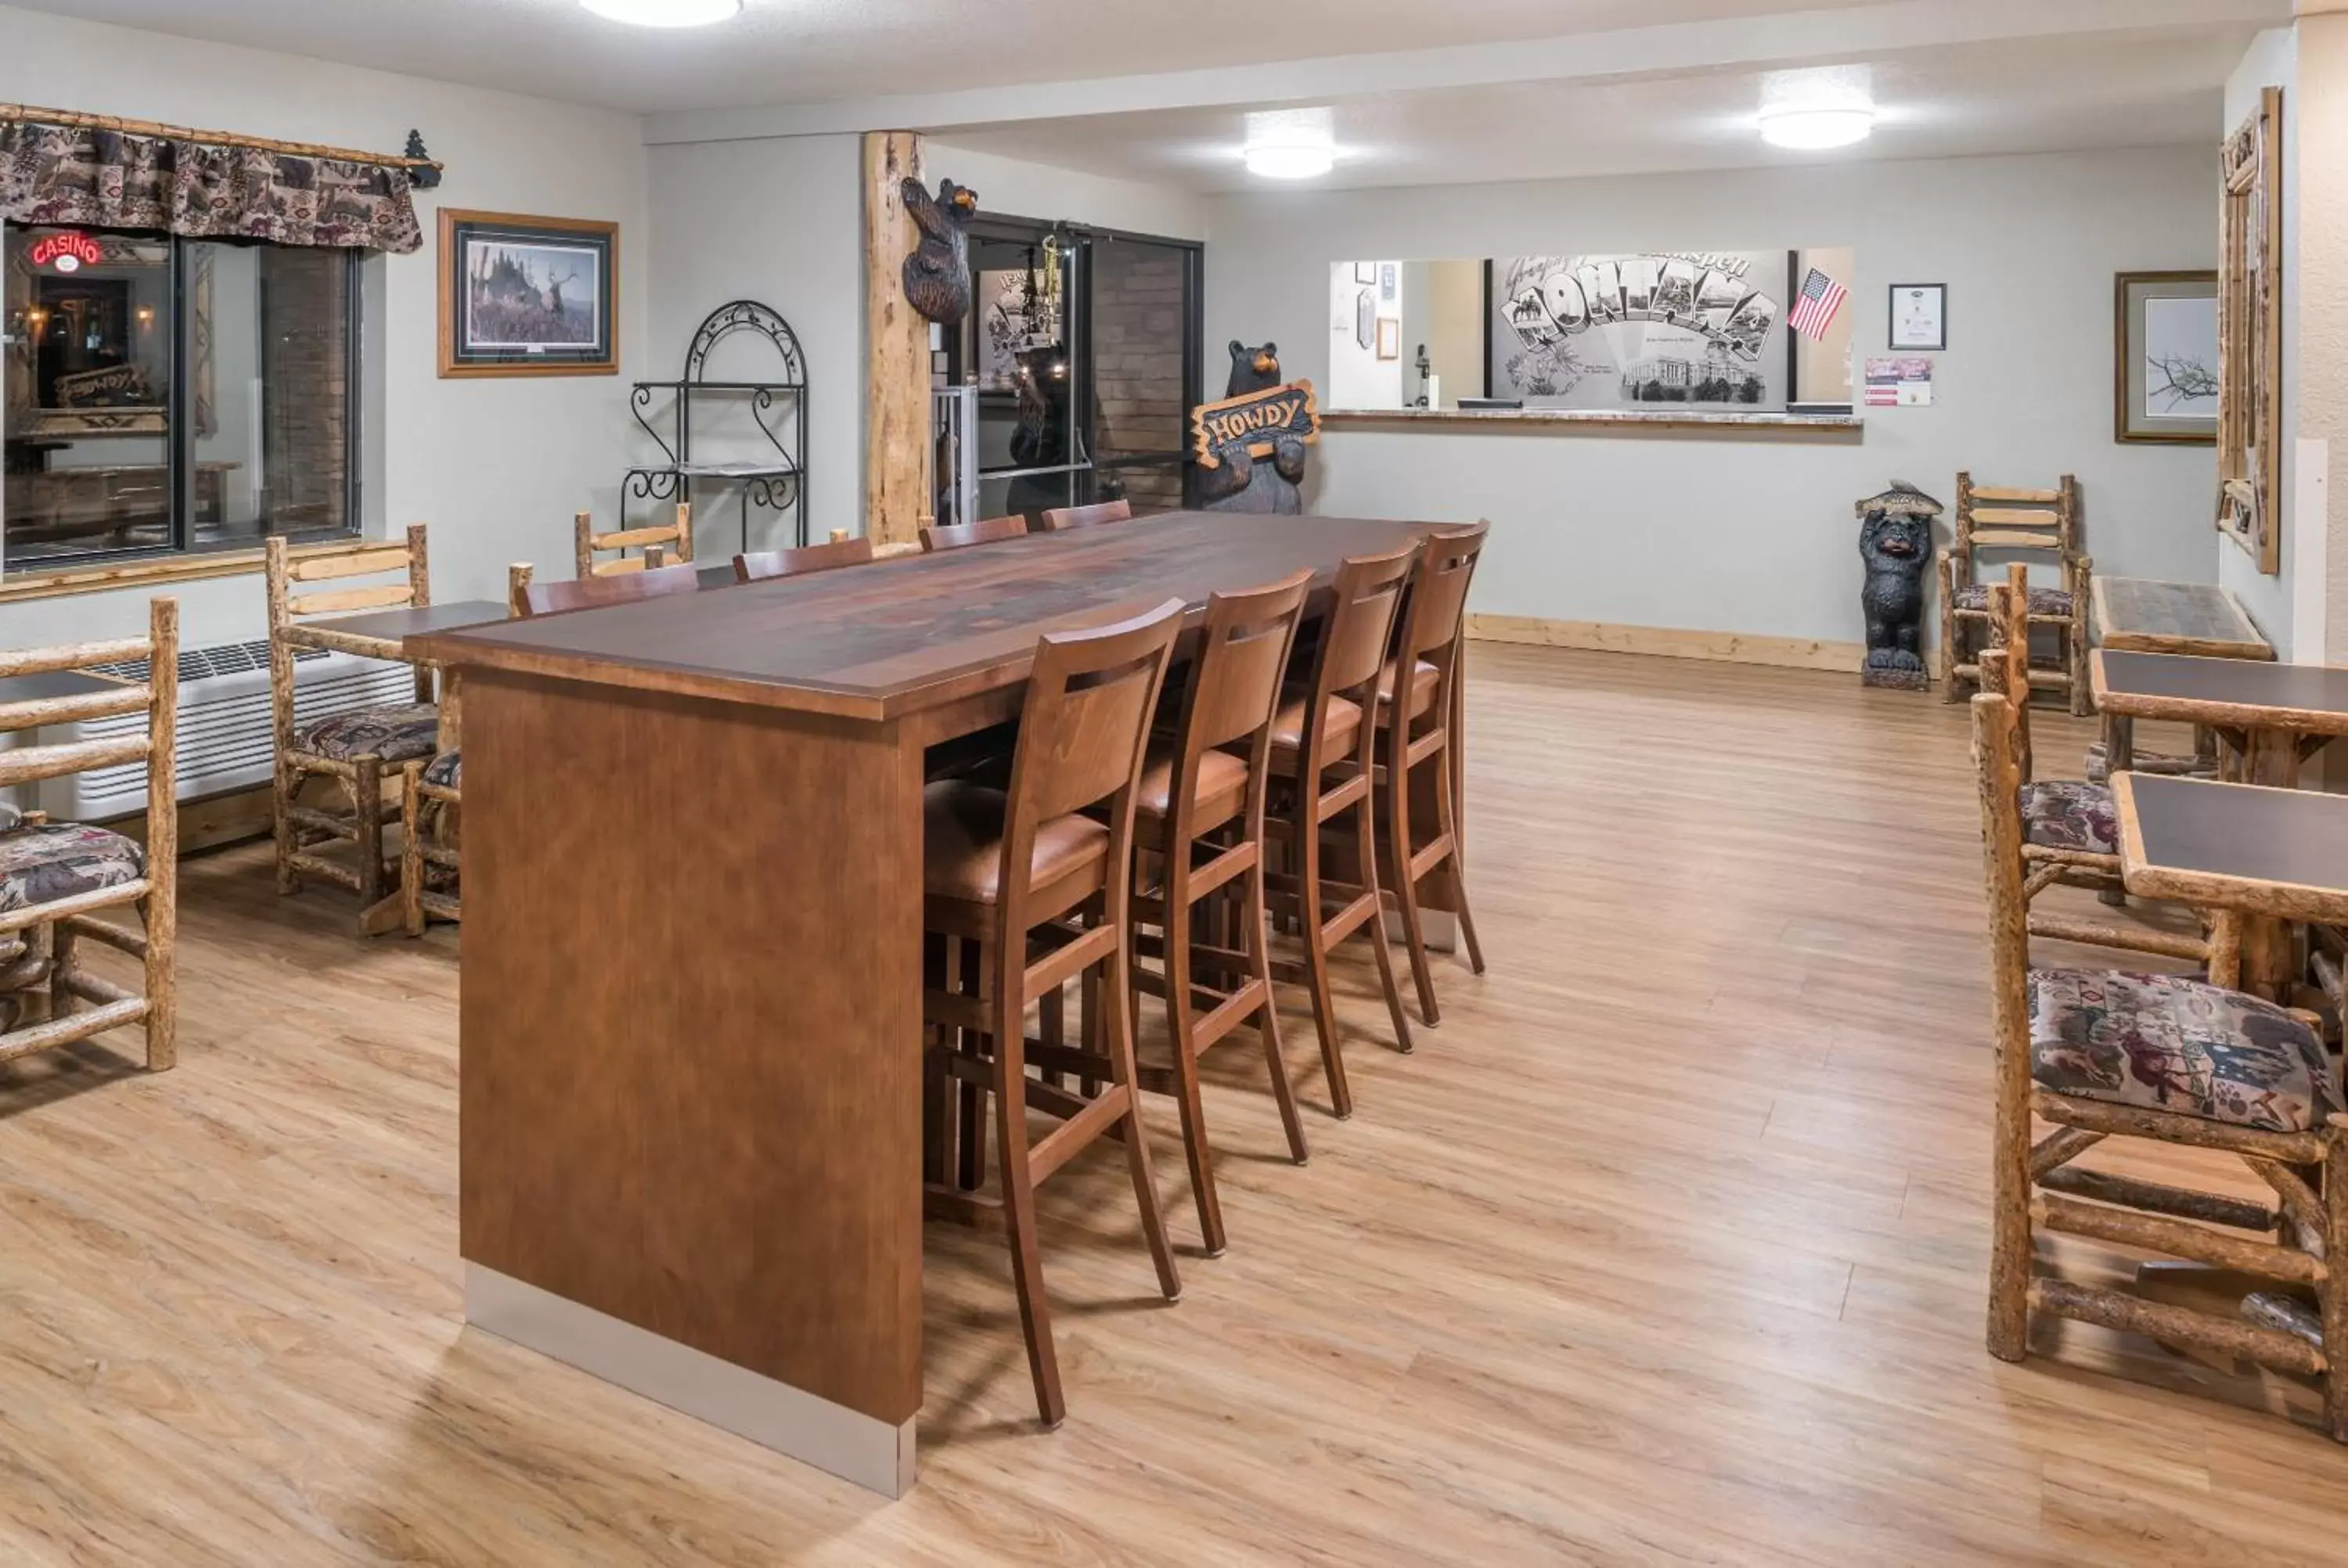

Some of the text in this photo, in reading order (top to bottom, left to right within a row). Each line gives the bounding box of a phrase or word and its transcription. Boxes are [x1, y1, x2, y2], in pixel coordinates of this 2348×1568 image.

[33, 236, 97, 264] CASINO
[1501, 261, 1778, 361] MONTANA
[1207, 399, 1301, 447] HOWDY
